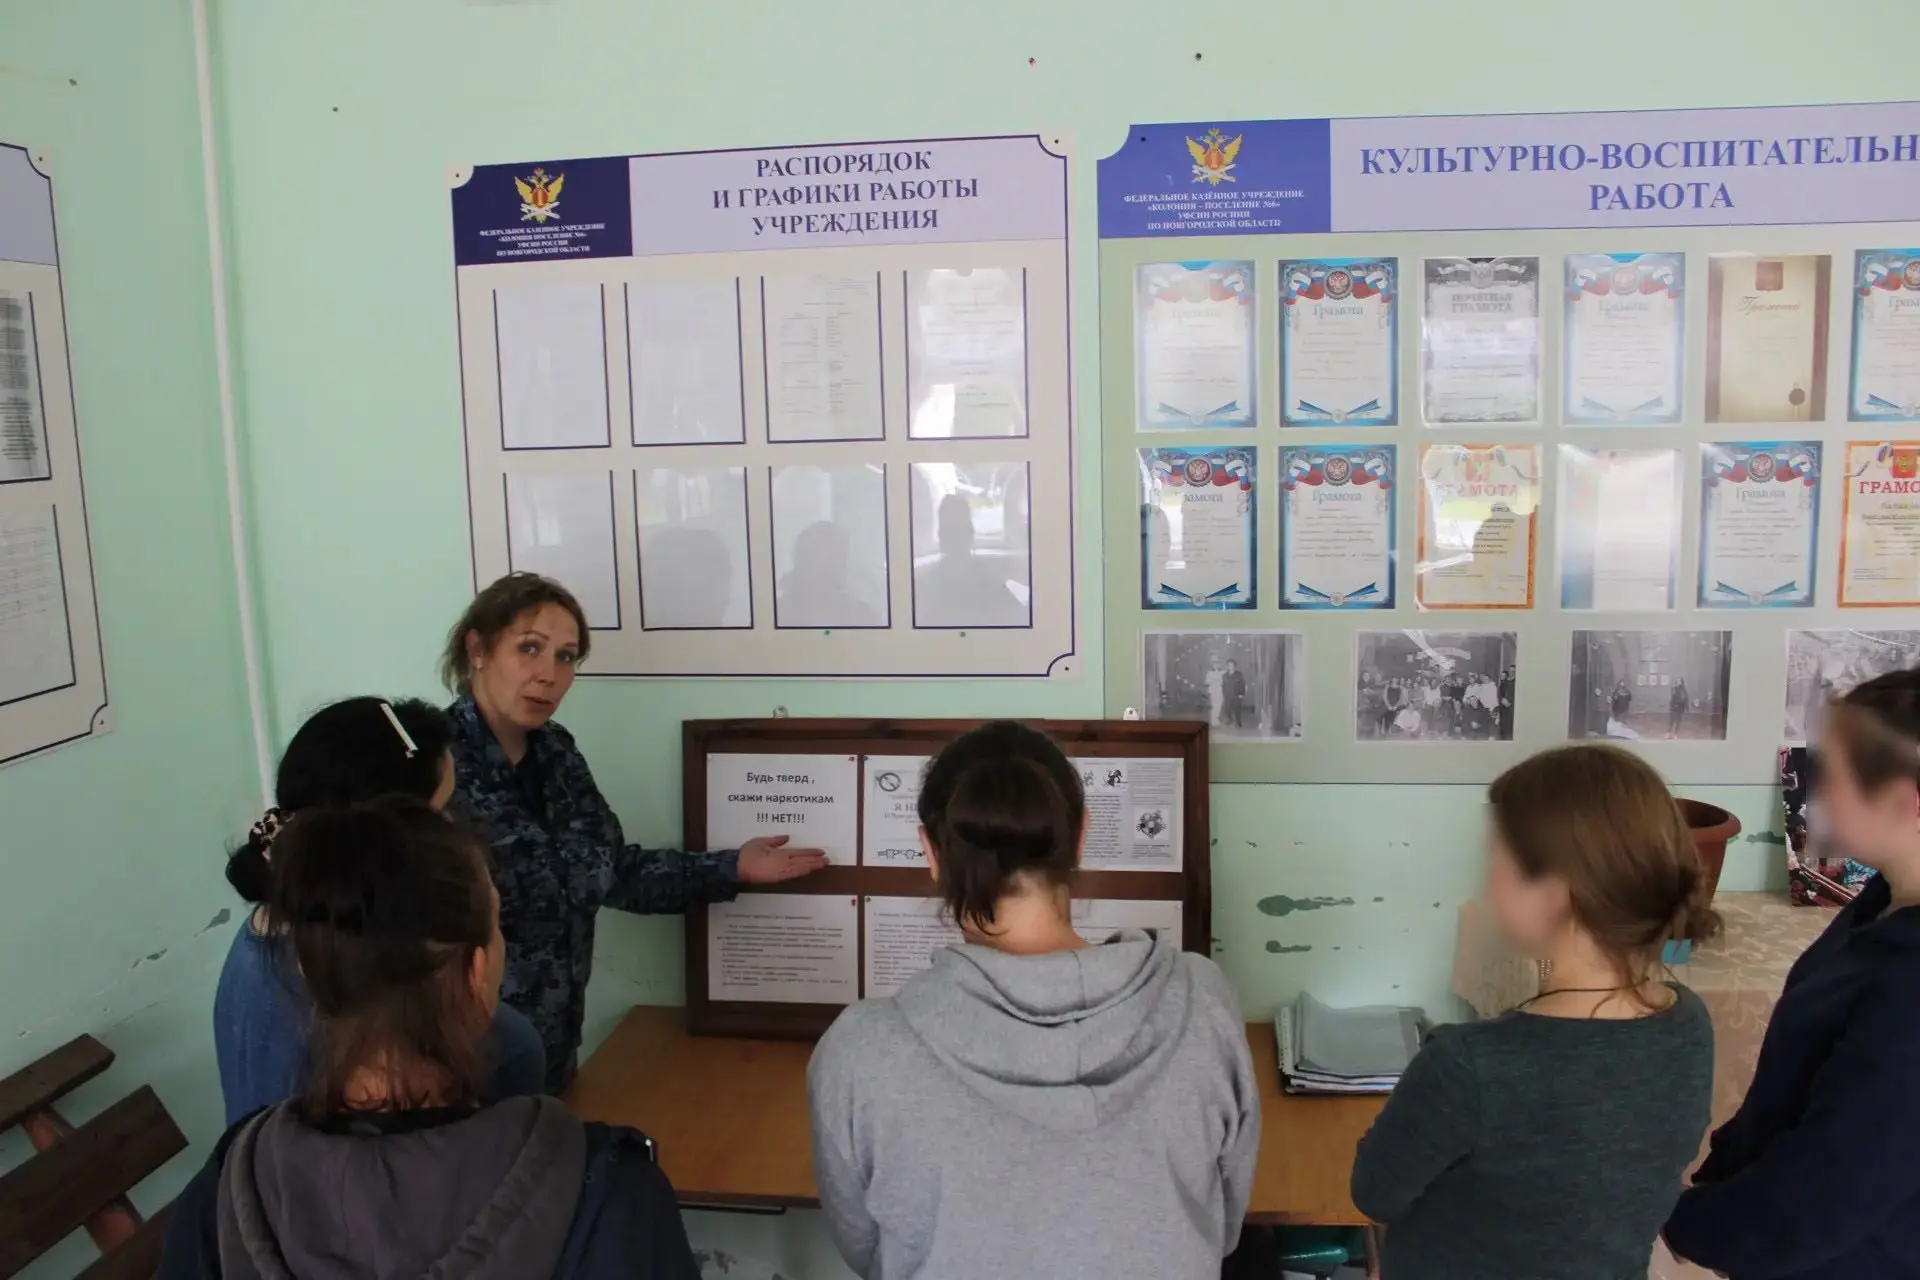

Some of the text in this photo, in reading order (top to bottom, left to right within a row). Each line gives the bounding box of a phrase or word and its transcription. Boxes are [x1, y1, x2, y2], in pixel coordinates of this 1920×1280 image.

[756, 151, 932, 178] РАСПОРЯДОК
[712, 178, 979, 209] И ГРАФИКИ РАБОТЫ
[1588, 182, 1735, 211] РАБОТА
[752, 209, 939, 236] УЧРЕЖДЕНИЯ
[746, 772, 774, 784] Будь
[776, 774, 809, 784] тверд
[727, 793, 834, 804] скажи наркотикам
[771, 813, 805, 823] НЕТ!!!
